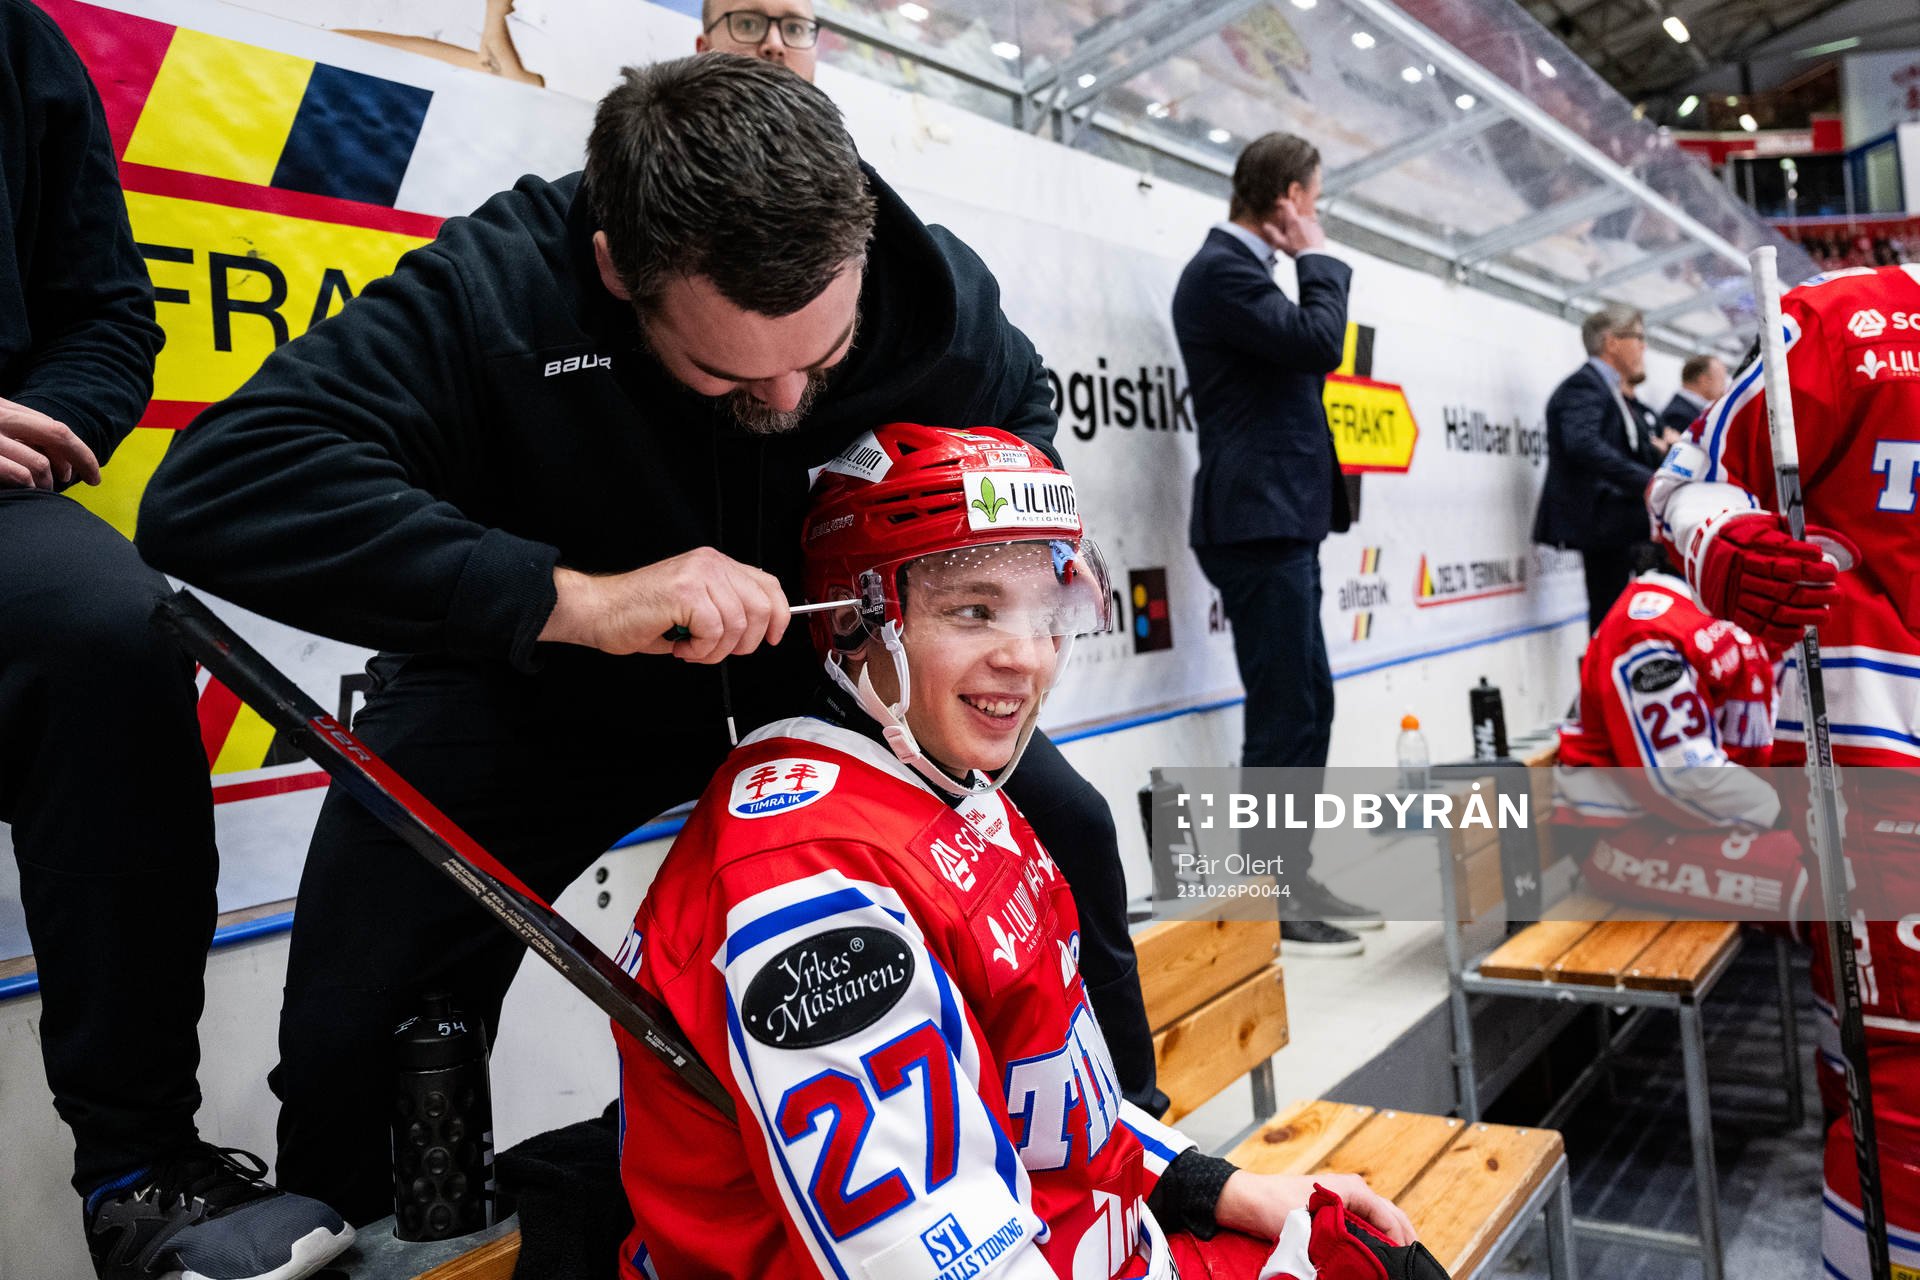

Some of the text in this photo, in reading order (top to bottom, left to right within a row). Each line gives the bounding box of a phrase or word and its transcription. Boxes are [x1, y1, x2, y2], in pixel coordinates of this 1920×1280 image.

[1010, 483, 1076, 515] LILIUM
[1338, 577, 1391, 611] alltank
[1642, 691, 1706, 750] 23
[750, 794, 801, 813] TIMRÅ IK
[1606, 848, 1754, 906] PEAB
[481, 895, 521, 931] SENSATION
[520, 928, 534, 940] ET
[507, 908, 525, 923] AND
[778, 951, 850, 1002] Yrkes
[767, 963, 905, 1042] Mästaren
[438, 1021, 467, 1036] 54
[775, 1018, 960, 1243] 27
[928, 1216, 967, 1267] ST
[974, 1217, 1024, 1266] TIDNING
